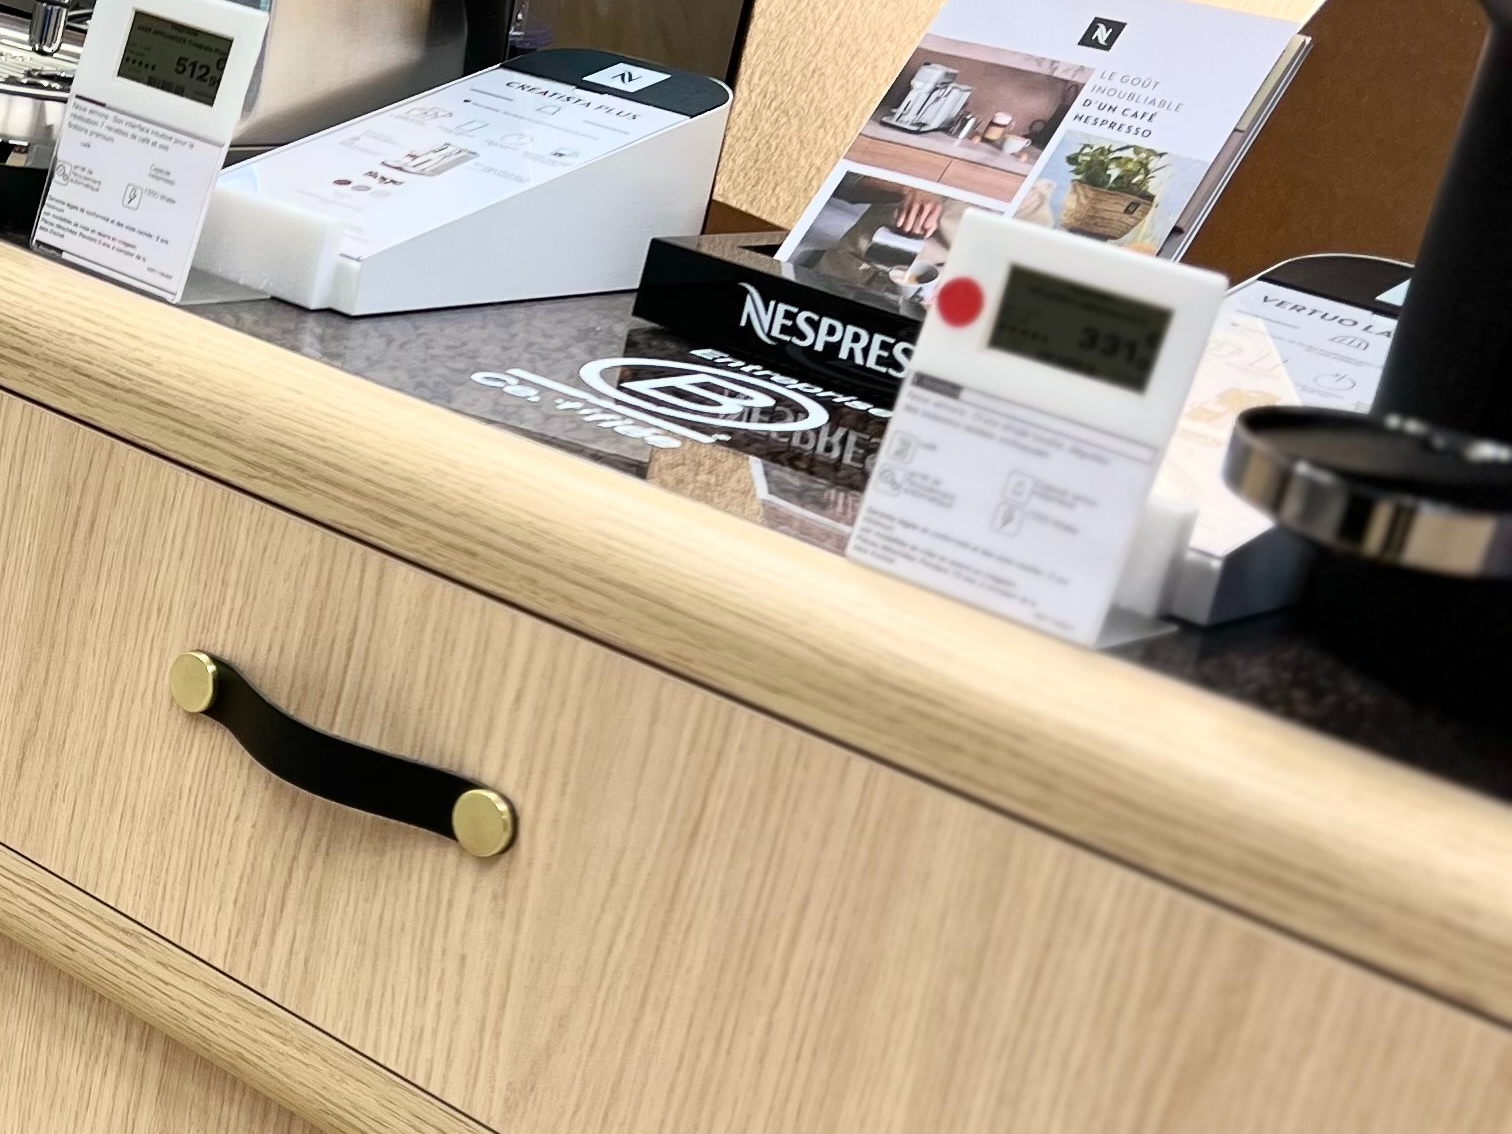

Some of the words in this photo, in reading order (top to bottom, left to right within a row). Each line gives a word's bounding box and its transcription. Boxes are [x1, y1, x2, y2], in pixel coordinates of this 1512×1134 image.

[1099, 69, 1117, 81] LE
[1120, 74, 1161, 91] GOÛT
[504, 80, 591, 109] CREATISTA
[593, 101, 642, 121] PLUS
[1082, 98, 1118, 114] D'UN
[1121, 107, 1159, 123] CAFÉ
[1090, 84, 1184, 113] INOUBLIABLE
[1072, 112, 1153, 139] NESPRESSO
[1262, 294, 1358, 328] VERTUO
